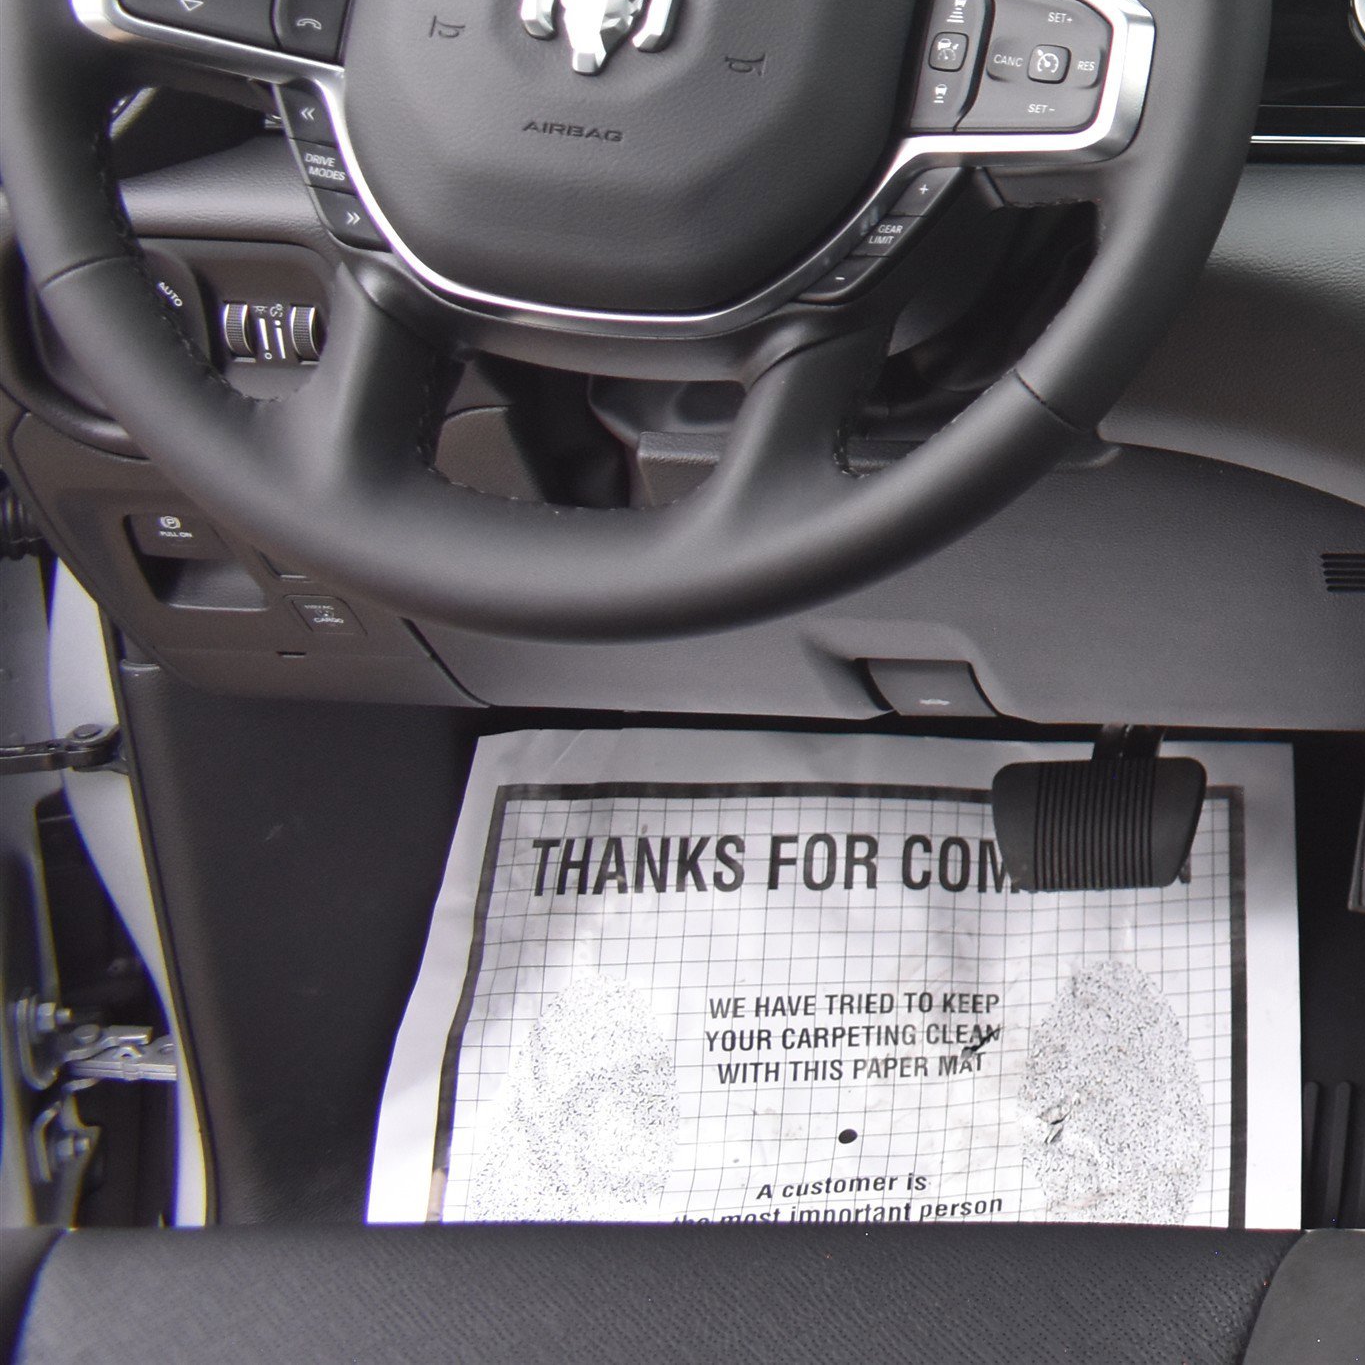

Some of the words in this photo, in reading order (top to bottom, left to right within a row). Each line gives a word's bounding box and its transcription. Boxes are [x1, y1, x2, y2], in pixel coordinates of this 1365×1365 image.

[993, 54, 1023, 67] CANC
[1077, 60, 1095, 71] RES
[522, 121, 623, 142] AIRBAG
[305, 153, 335, 167] DRIVE
[308, 166, 346, 181] MODES
[868, 236, 894, 244] LIMIT
[878, 225, 903, 234] GEAR
[159, 281, 183, 307] AUTO
[160, 530, 178, 538] PULL
[532, 833, 746, 897] THANKS
[767, 832, 878, 893] FOR
[709, 997, 746, 1019] WE
[755, 995, 817, 1018] HAVE
[824, 992, 895, 1016] TRIED
[904, 991, 933, 1013] TO
[942, 993, 1000, 1014] KEEP
[705, 1028, 772, 1052] YOUR
[781, 1023, 917, 1050] CARPETING
[926, 1023, 1001, 1045] CLEAN
[718, 1062, 780, 1084] WITH
[789, 1059, 843, 1082] THIS
[853, 1056, 929, 1080] PAPER
[938, 1052, 987, 1077] MAT
[756, 1183, 773, 1200] A
[782, 1175, 899, 1198] customer
[906, 1172, 928, 1191] is
[919, 1197, 1003, 1222] person
